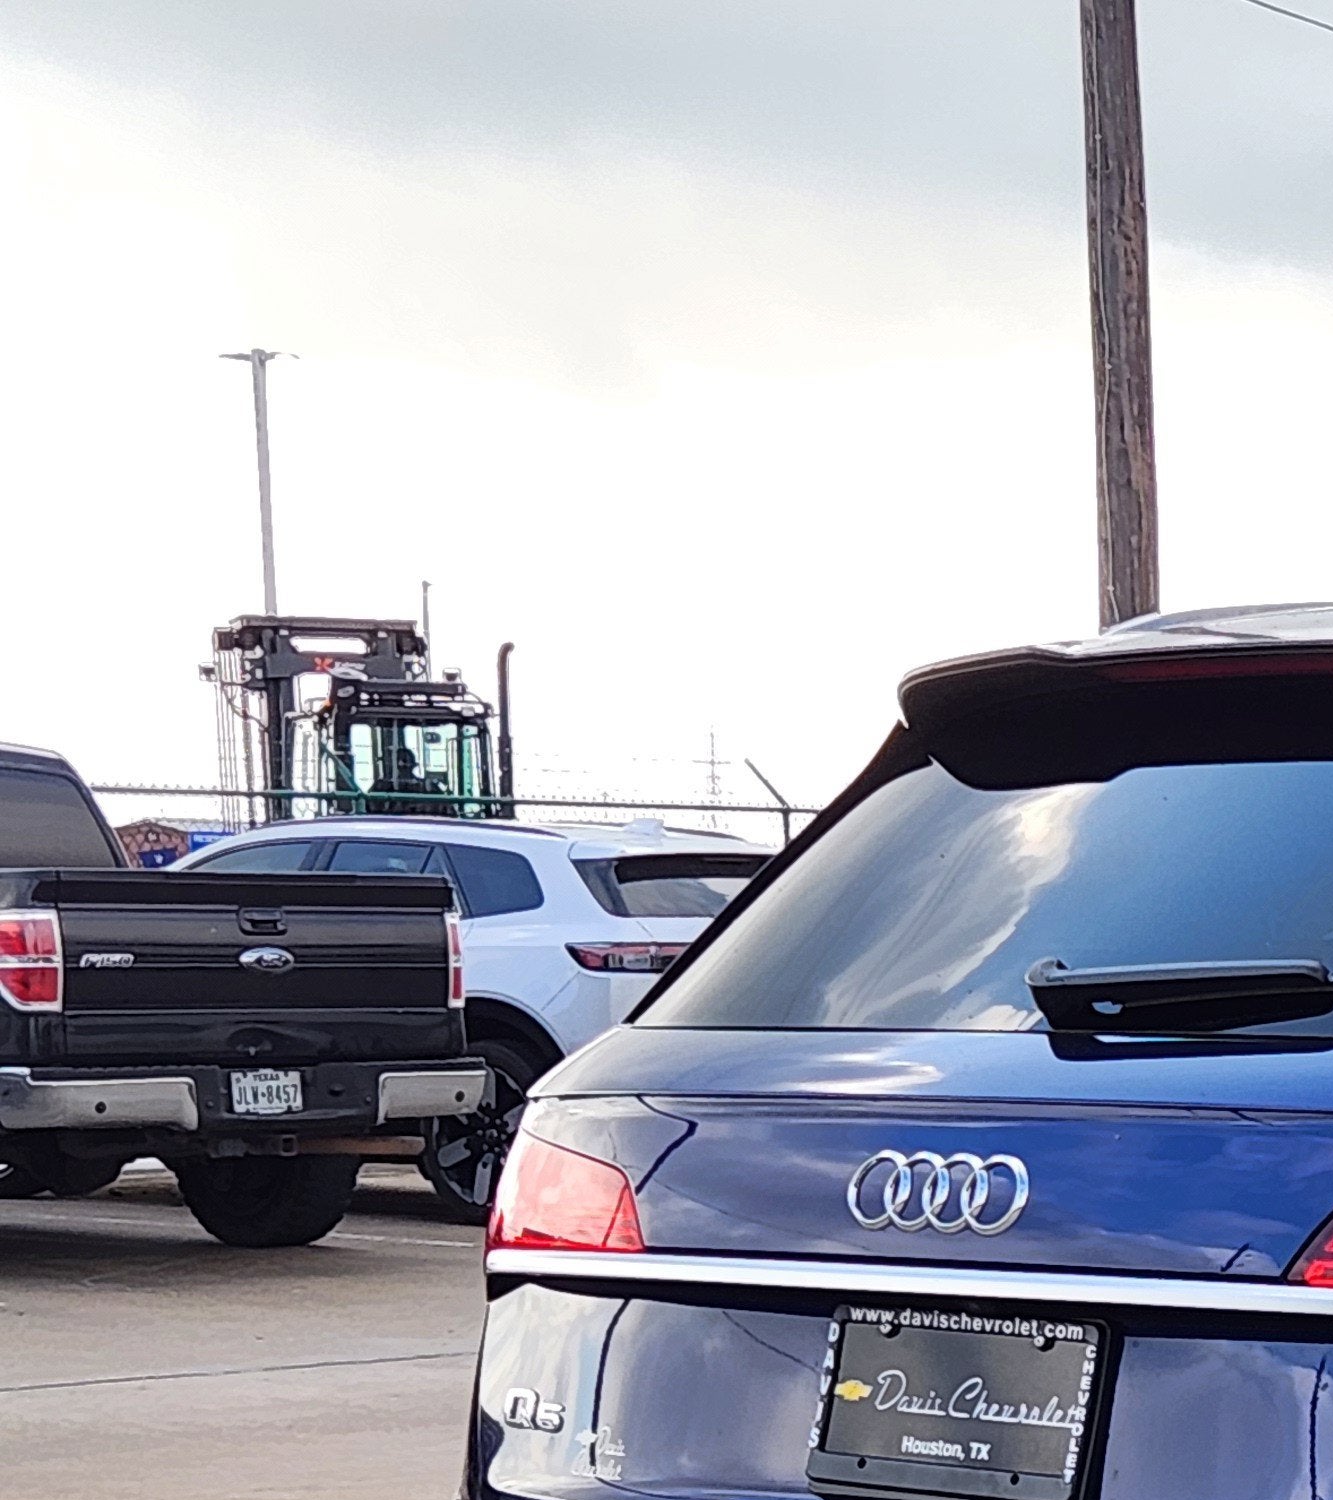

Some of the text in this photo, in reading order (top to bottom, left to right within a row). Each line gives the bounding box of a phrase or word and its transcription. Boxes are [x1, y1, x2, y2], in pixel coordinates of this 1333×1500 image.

[850, 1306, 1084, 1341] www.davischevrolet.com
[504, 1387, 565, 1433] Q5
[808, 1322, 840, 1449] DAVIS
[874, 1369, 1078, 1429] Davis Chevrolet
[1062, 1344, 1098, 1485] CHEVROLET
[901, 1435, 992, 1462] Houston, TX
